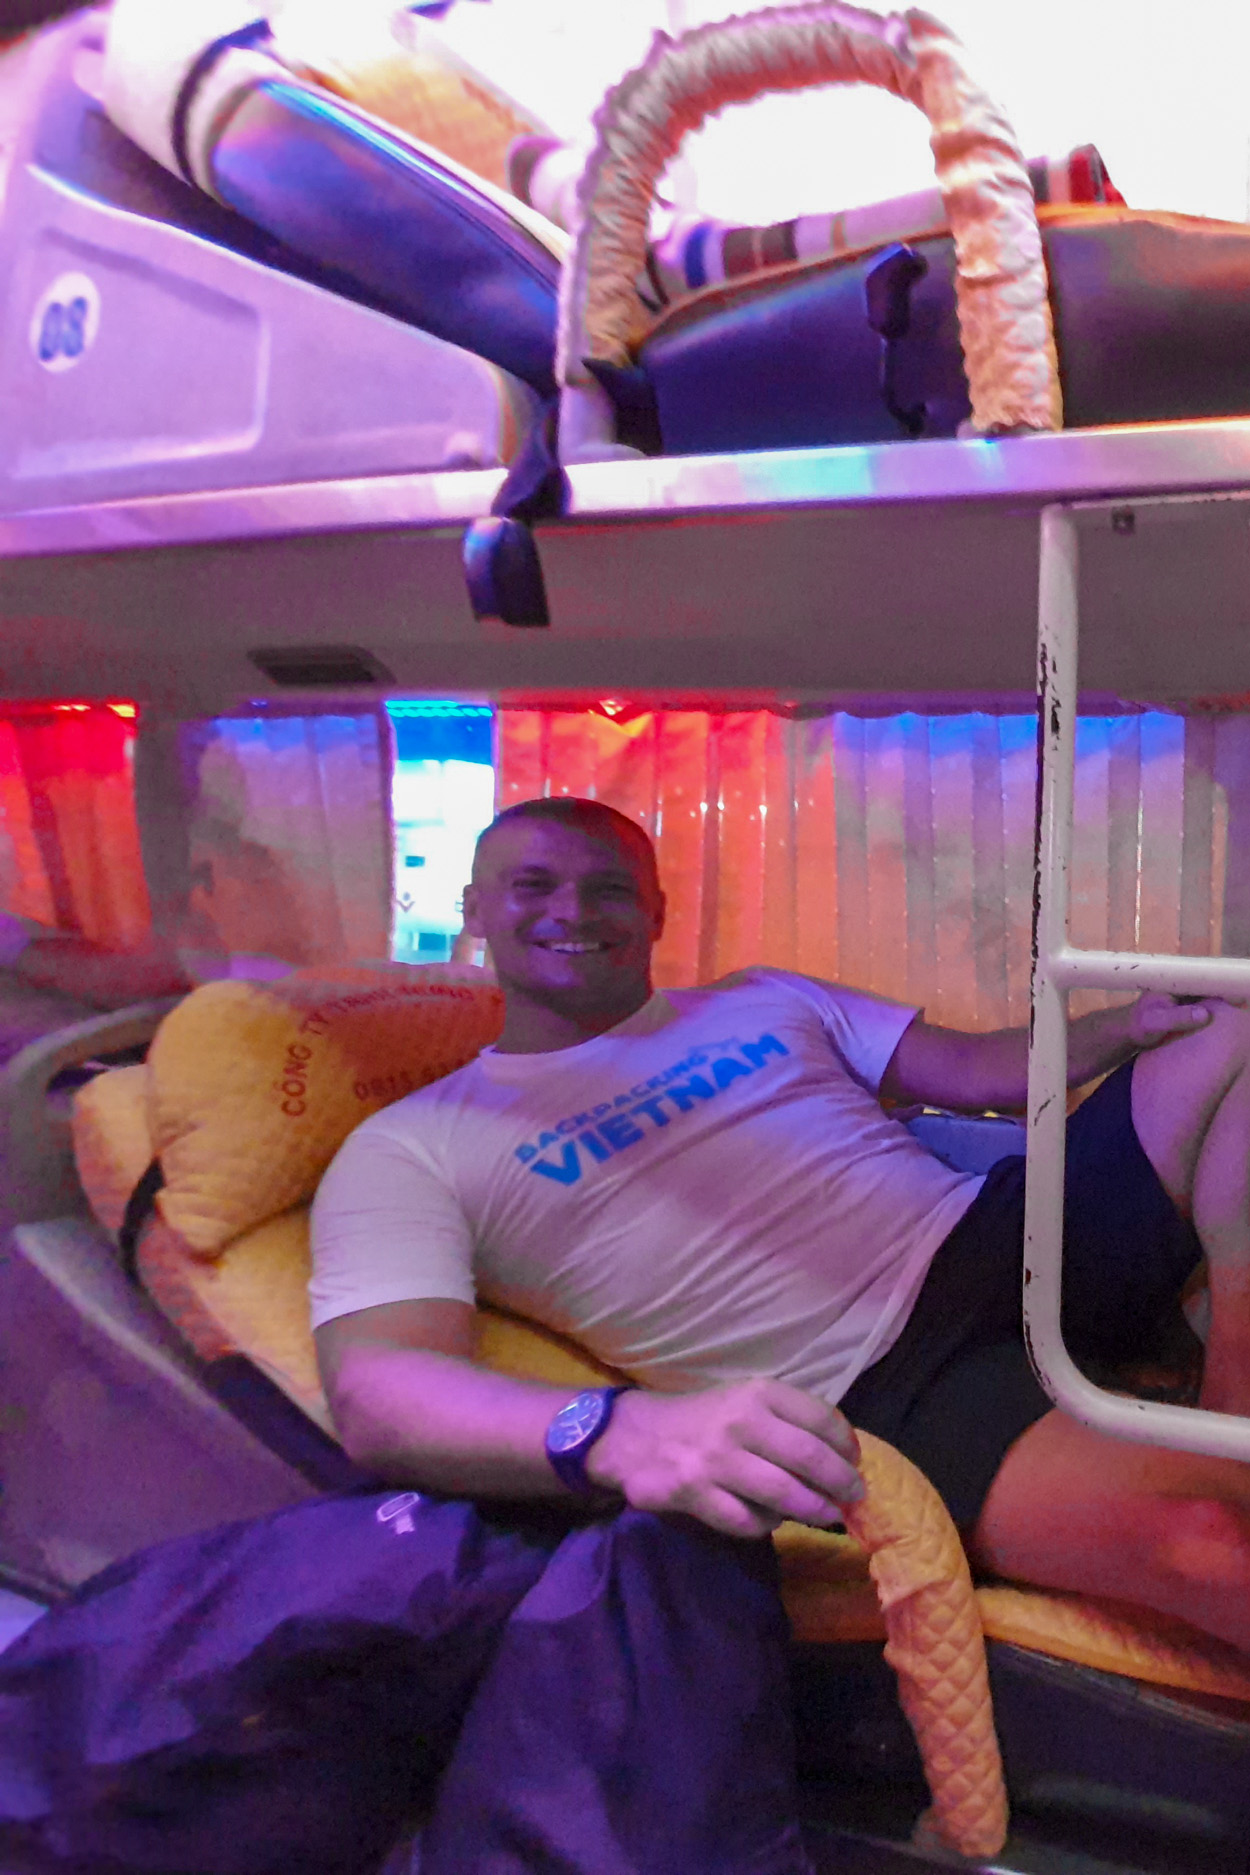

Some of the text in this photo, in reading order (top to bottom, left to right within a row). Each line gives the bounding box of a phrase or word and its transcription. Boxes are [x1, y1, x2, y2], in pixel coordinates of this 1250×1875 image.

[38, 296, 89, 361] 08
[514, 1052, 709, 1164] BACKPACKING
[530, 1032, 790, 1186] VIETNAM
